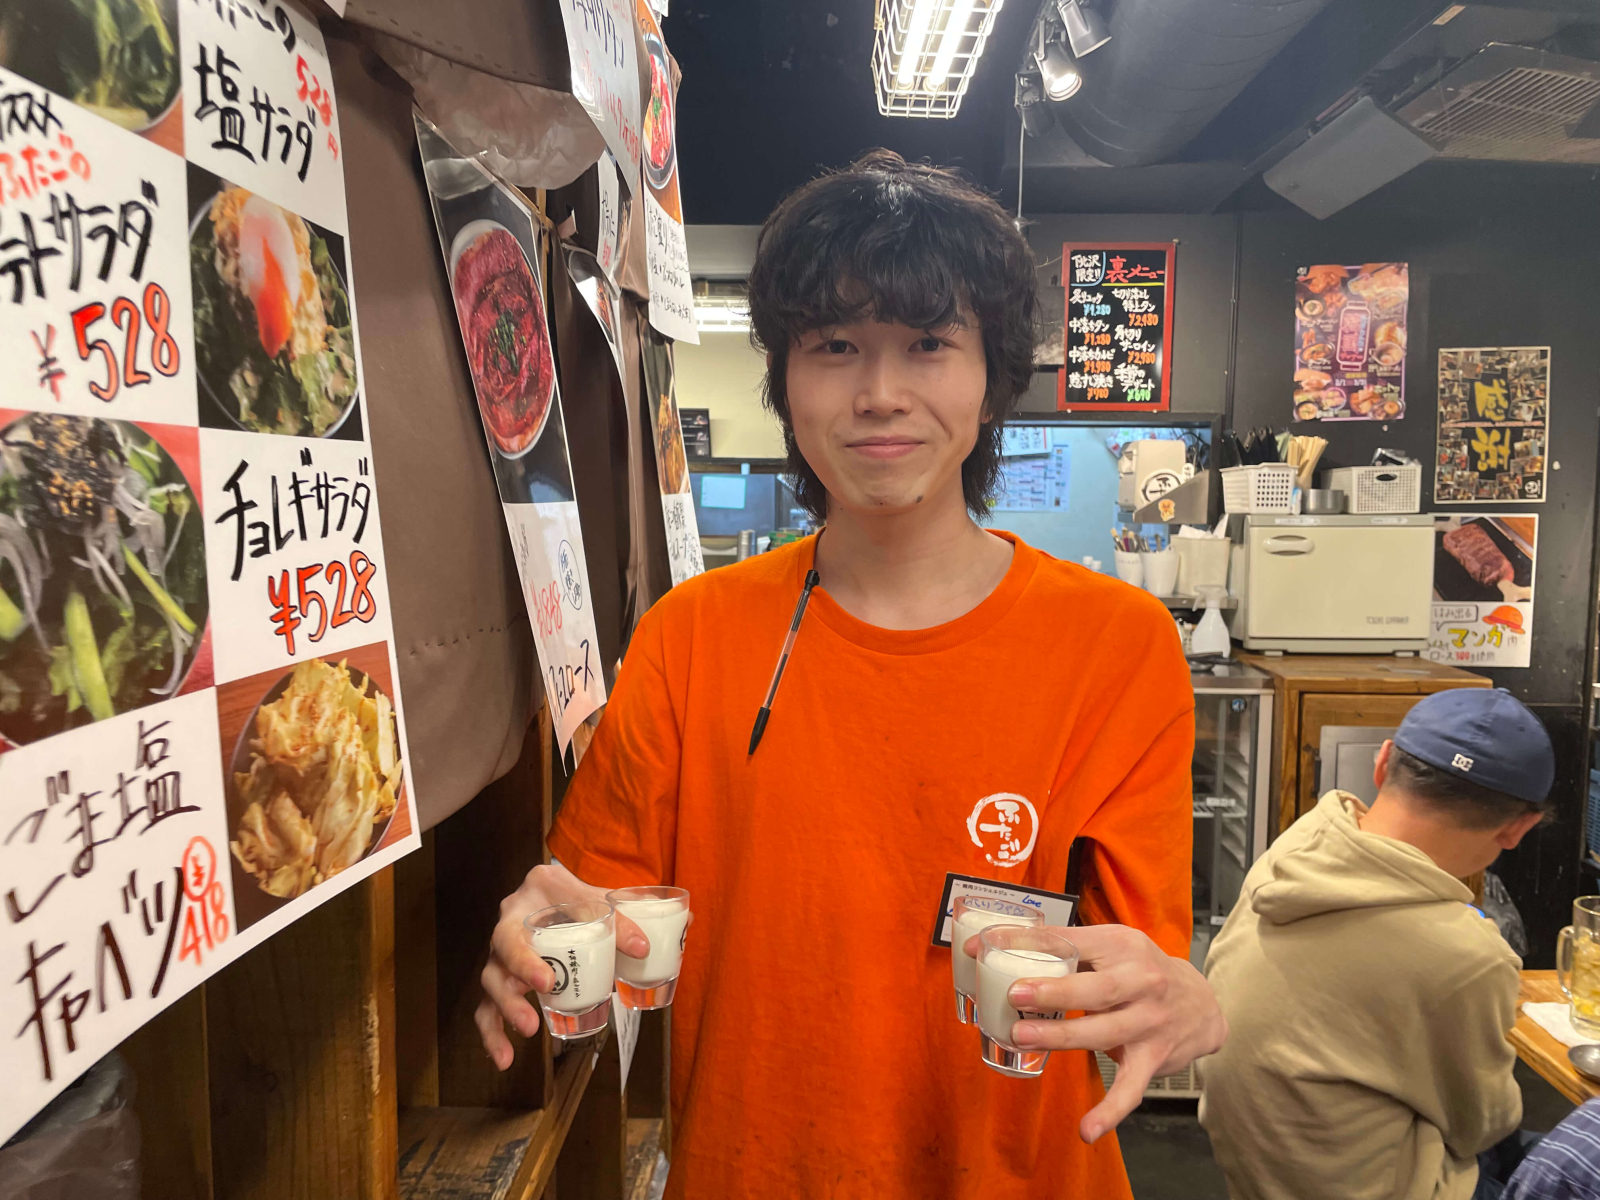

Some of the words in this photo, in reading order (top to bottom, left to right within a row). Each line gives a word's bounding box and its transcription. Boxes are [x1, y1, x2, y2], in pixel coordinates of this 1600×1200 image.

[193, 42, 317, 183] 塩サラダ
[1105, 255, 1165, 283] 裏メニュー
[31, 281, 180, 402] ¥528
[1068, 316, 1110, 333] 中落ちタン
[1068, 345, 1116, 364] 中落ちカルビ
[1119, 339, 1156, 353] サーロイン
[1121, 378, 1156, 392] デザート
[215, 447, 371, 582] チョレギサラダ
[268, 550, 376, 656] ¥528
[16, 866, 185, 1082] キャベツ
